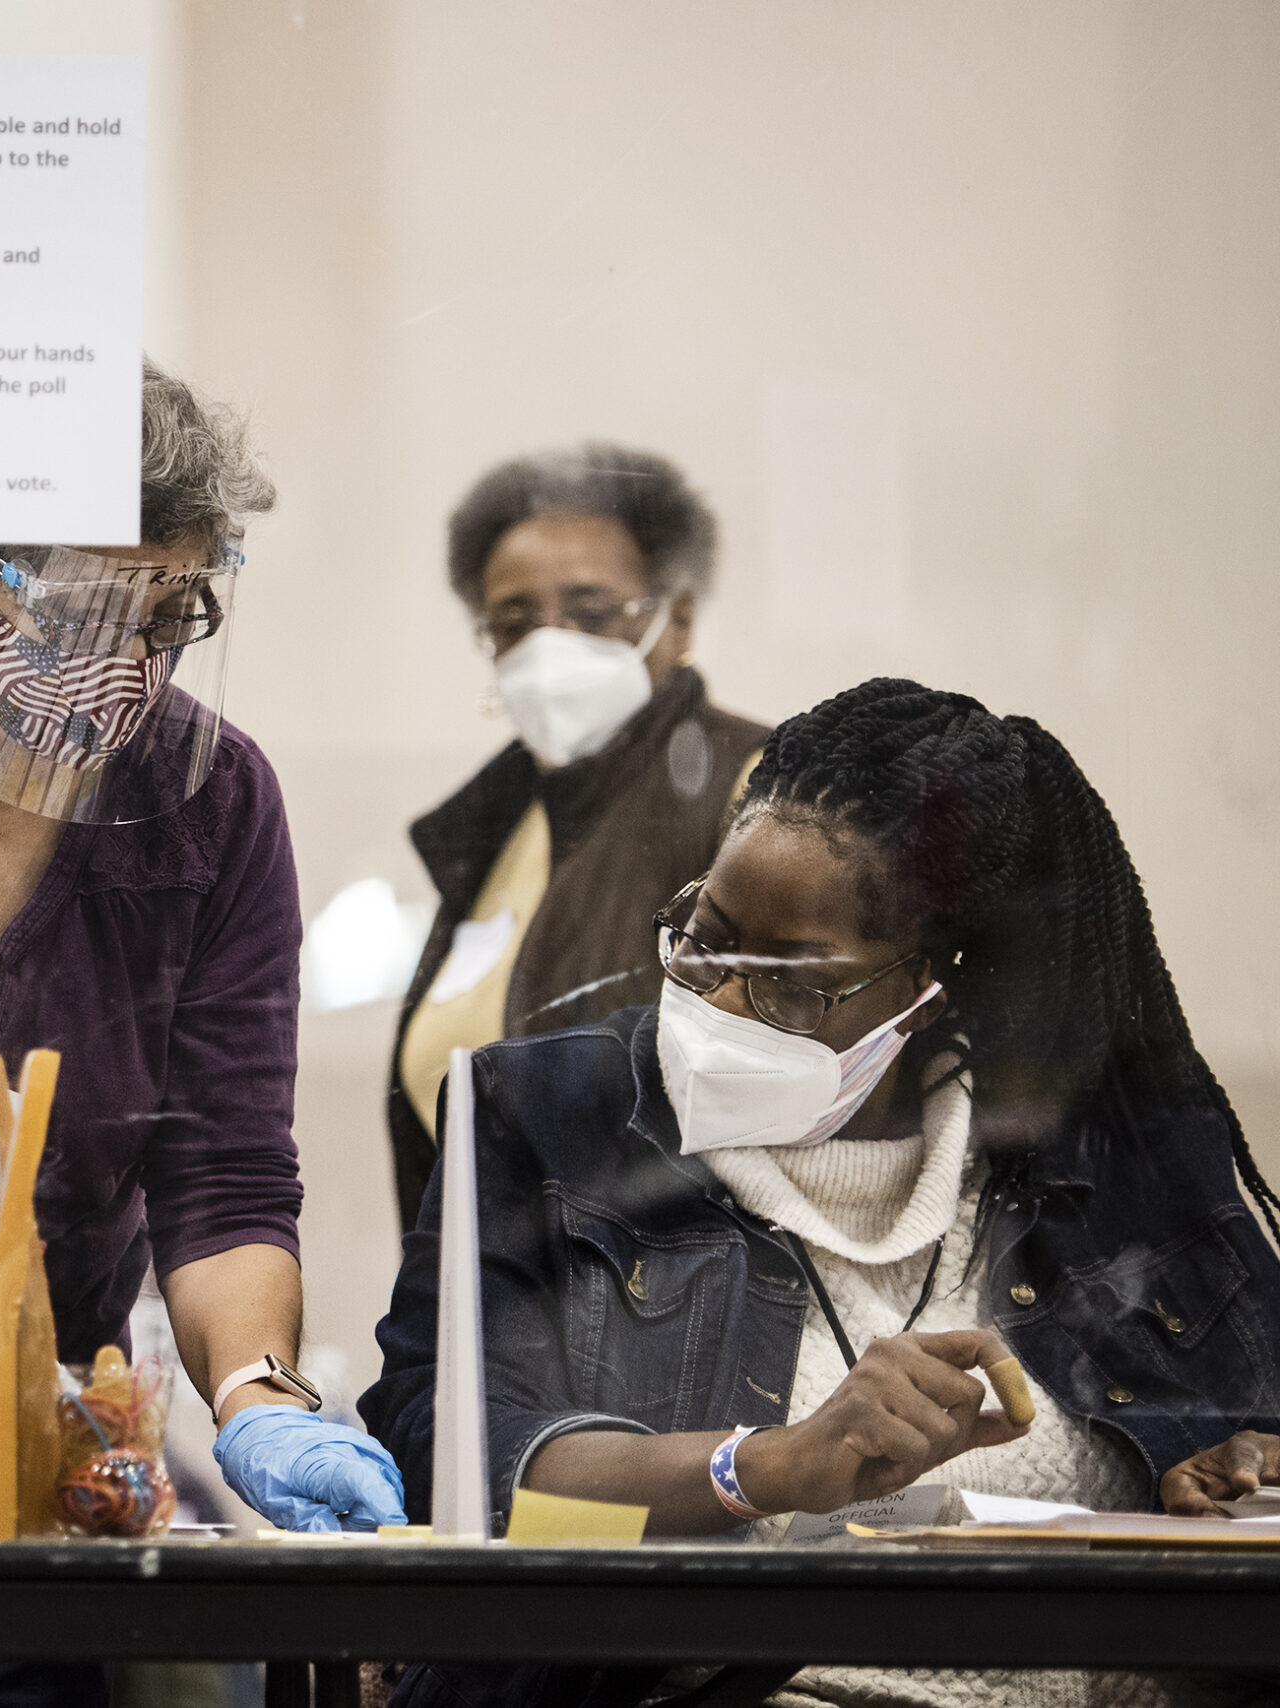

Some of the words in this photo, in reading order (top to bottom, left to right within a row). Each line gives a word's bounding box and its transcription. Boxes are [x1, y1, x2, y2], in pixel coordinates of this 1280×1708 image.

[32, 117, 70, 135] and
[76, 117, 121, 136] hold
[8, 151, 30, 167] to
[35, 149, 70, 168] the
[2, 247, 41, 264] and
[34, 345, 95, 362] hands
[28, 377, 66, 397] poll
[6, 476, 57, 492] vote.
[829, 1506, 896, 1522] OFFICIAL
